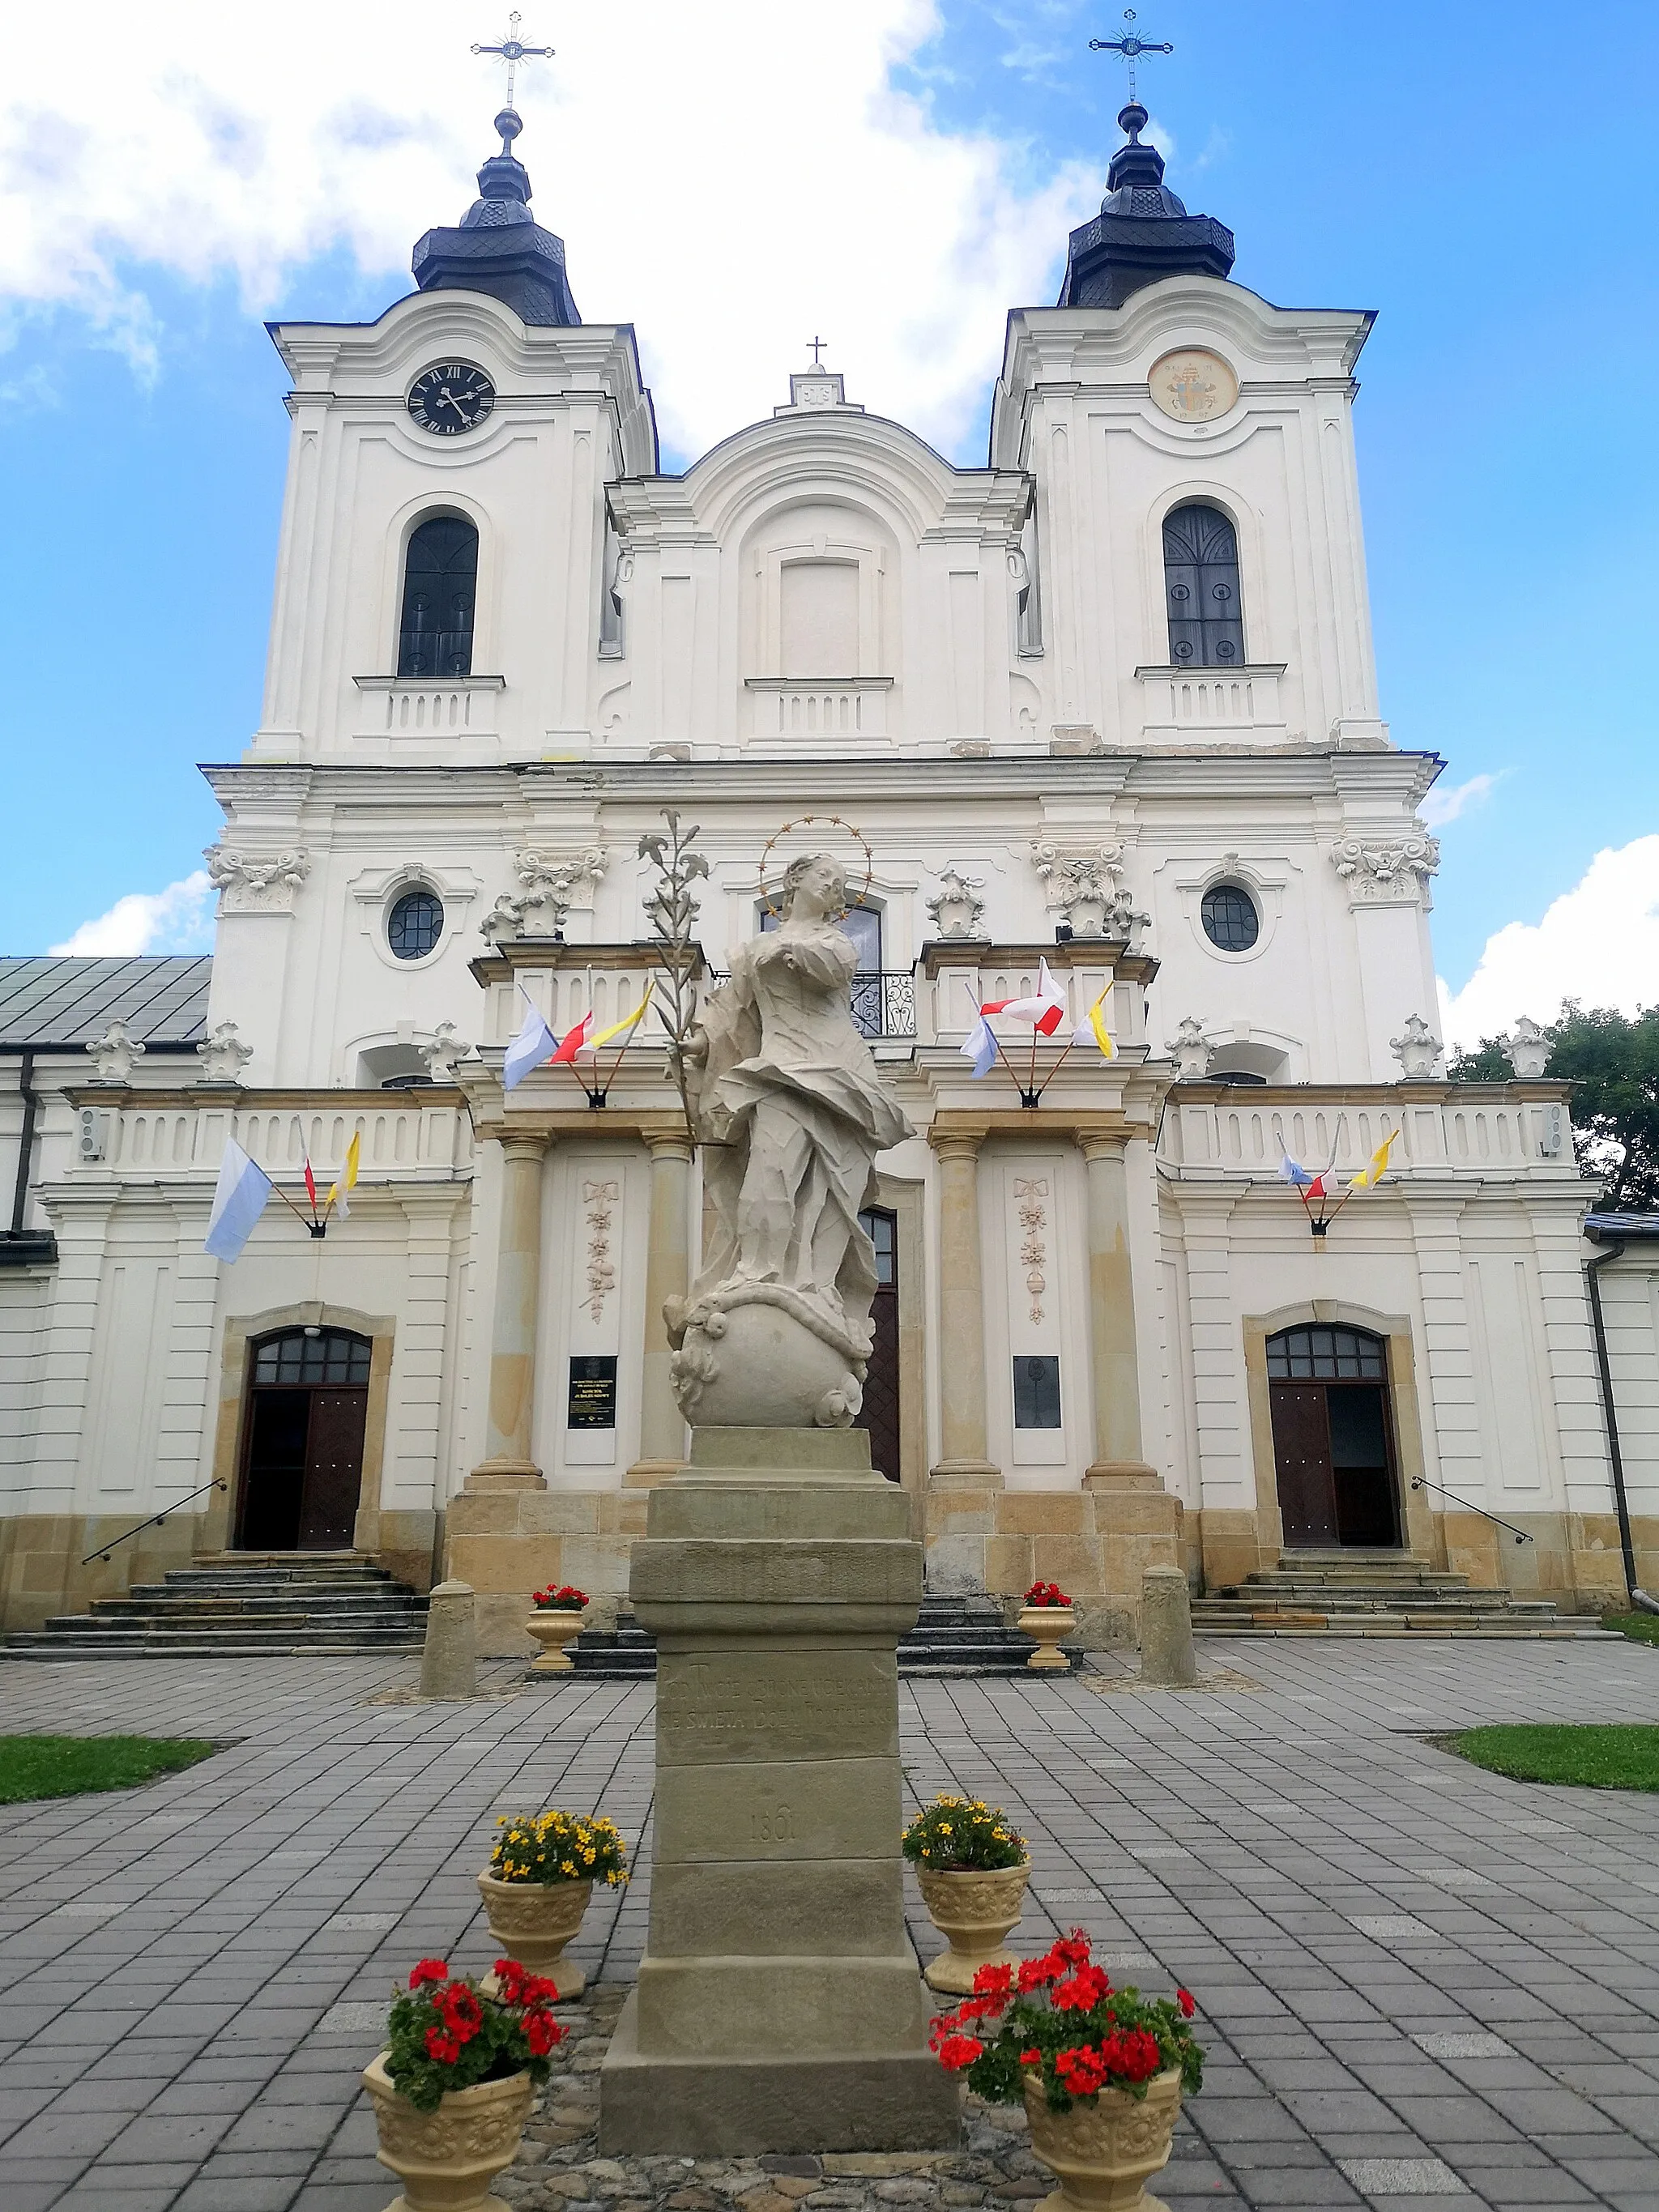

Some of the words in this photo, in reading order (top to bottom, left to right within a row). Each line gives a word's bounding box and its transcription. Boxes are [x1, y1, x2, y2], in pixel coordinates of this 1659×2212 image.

[428, 369, 442, 384] XI
[446, 366, 461, 379] XII
[466, 371, 476, 382] I
[415, 382, 429, 393] X
[475, 381, 491, 392] II
[409, 397, 424, 407] IX
[480, 397, 493, 407] III
